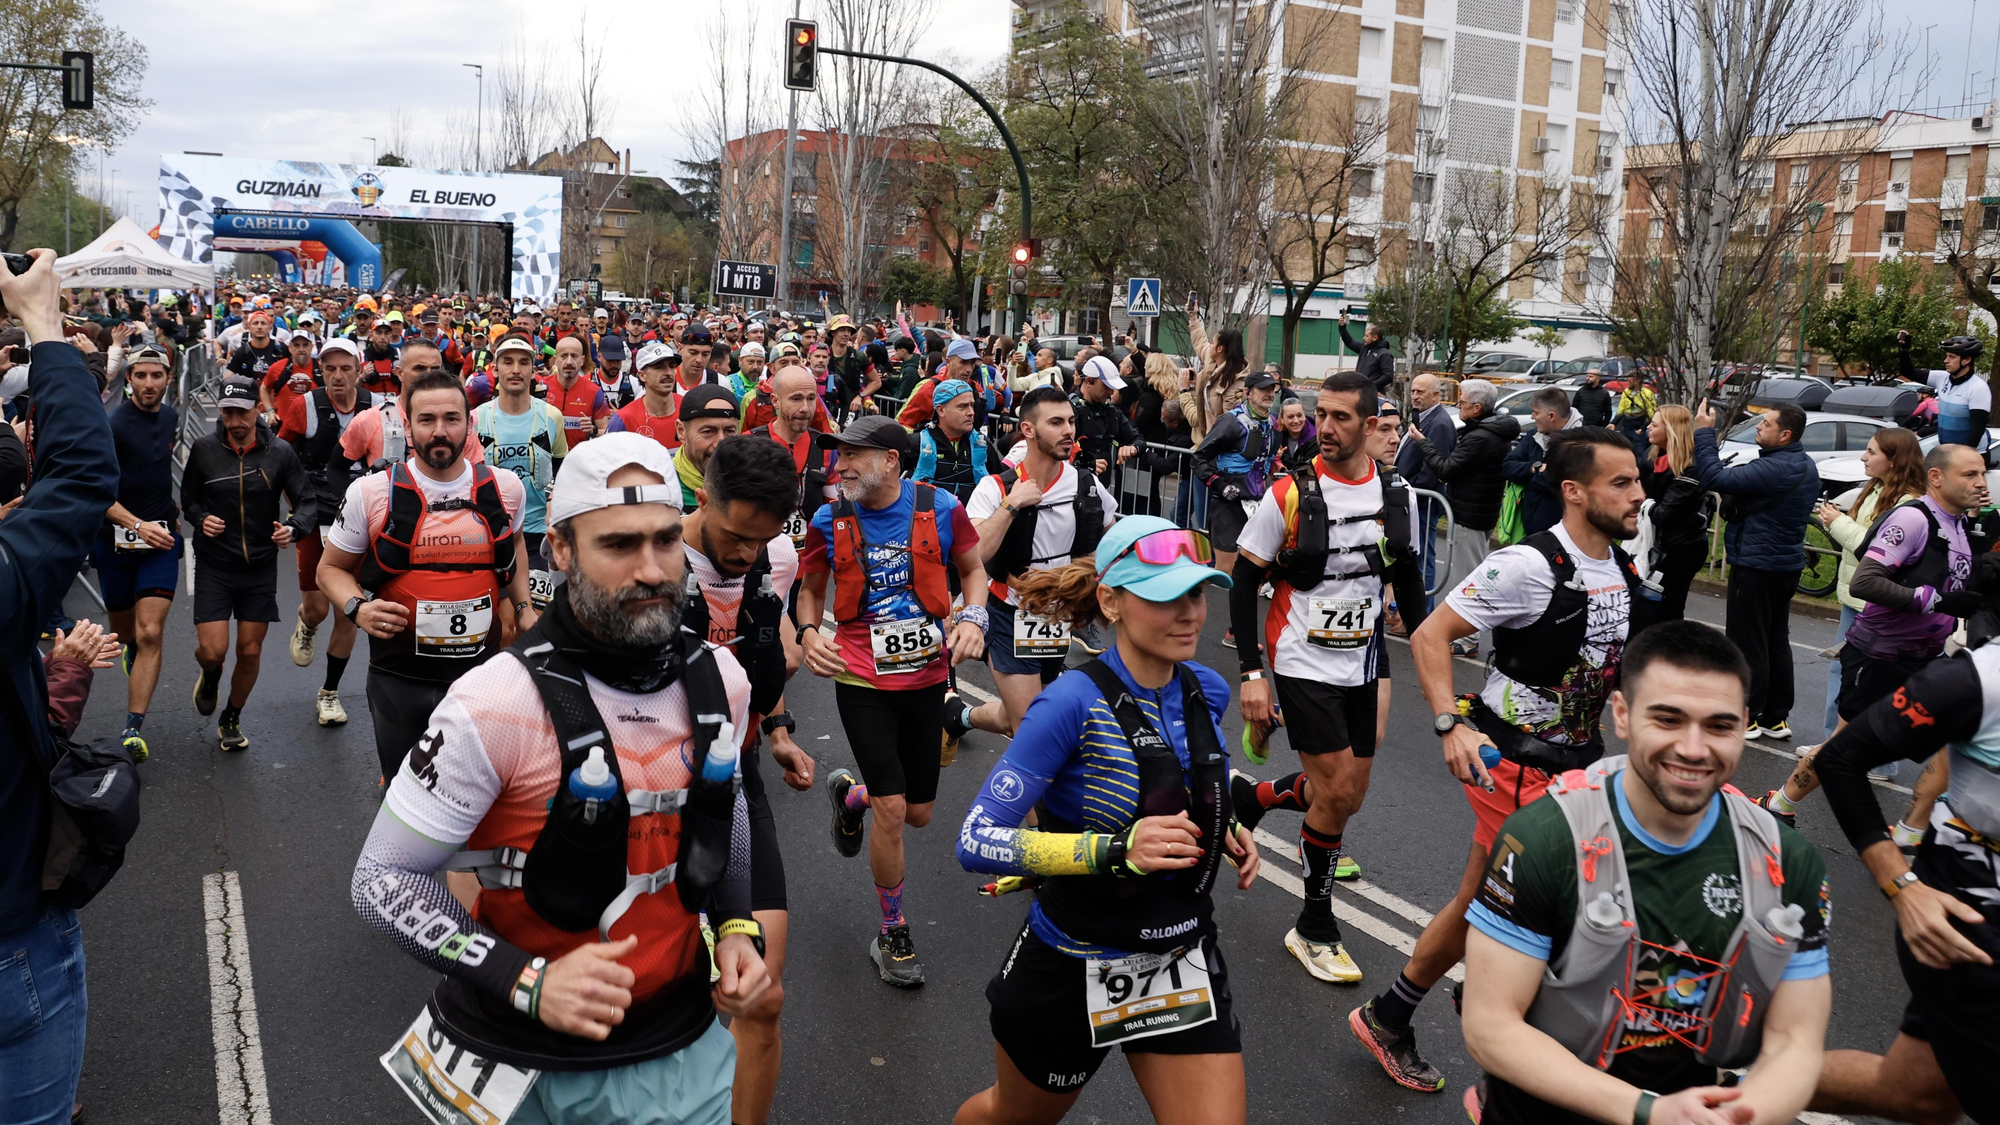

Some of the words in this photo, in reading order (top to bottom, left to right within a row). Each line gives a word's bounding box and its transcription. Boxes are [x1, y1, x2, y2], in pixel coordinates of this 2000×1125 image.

[236, 179, 322, 198] GUZMÁN
[409, 189, 430, 204] EL
[434, 190, 496, 207] BUENO
[232, 216, 310, 231] CABELLO
[736, 264, 760, 274] ACCESO
[732, 273, 762, 291] MTB
[782, 519, 803, 536] 98
[529, 577, 552, 597] 930
[449, 614, 467, 635] 8
[1023, 621, 1063, 639] 743
[1321, 610, 1365, 630] 741
[885, 628, 933, 655] 858
[980, 843, 1014, 863] CLUB
[1319, 849, 1340, 896] kalenji
[1139, 916, 1198, 940] SALOMON
[1107, 957, 1183, 1004] 971
[1123, 1019, 1147, 1033] TRAIL
[1146, 1012, 1180, 1027] RUNING
[1048, 1071, 1087, 1087] PILAR
[412, 1074, 429, 1101] TRAIL
[428, 1094, 458, 1125] RUNING
